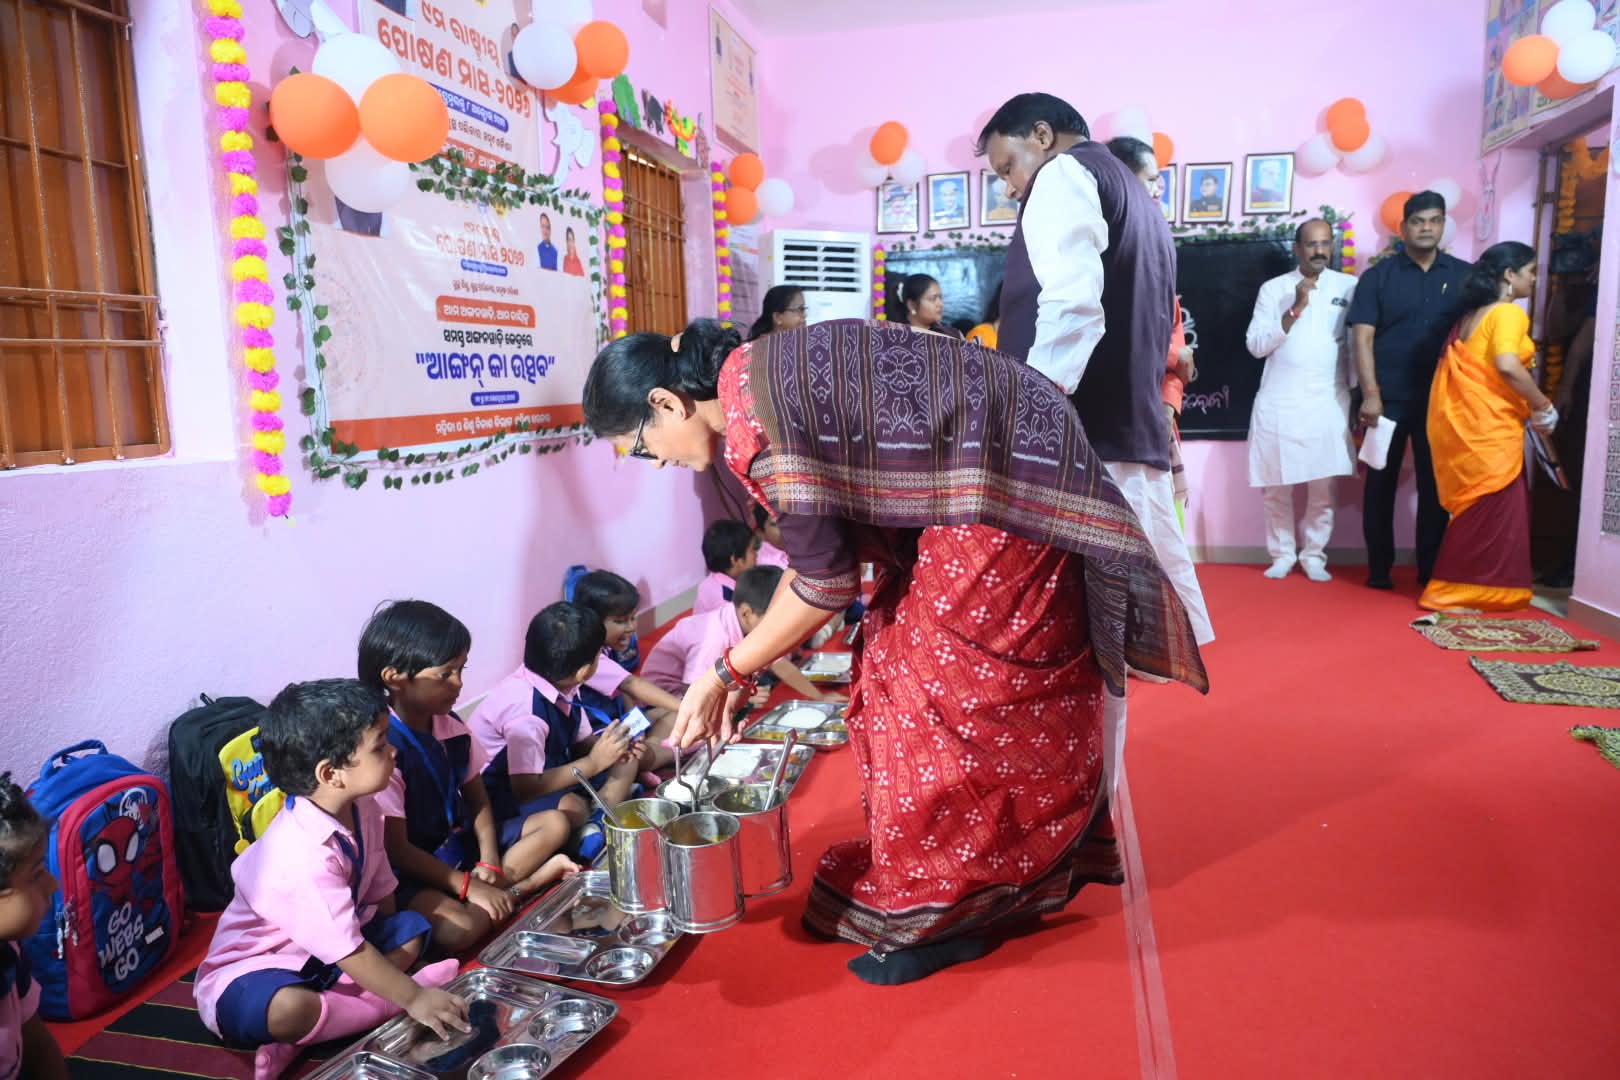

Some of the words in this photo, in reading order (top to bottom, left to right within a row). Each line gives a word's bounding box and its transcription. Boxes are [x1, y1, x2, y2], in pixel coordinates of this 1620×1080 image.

[377, 18, 453, 79] ପୋଷଣ
[443, 329, 465, 347] ସମସ୍ତ
[488, 354, 508, 378] କା
[108, 901, 131, 934] GO
[98, 913, 144, 968] WEBS
[114, 947, 139, 980] GO
